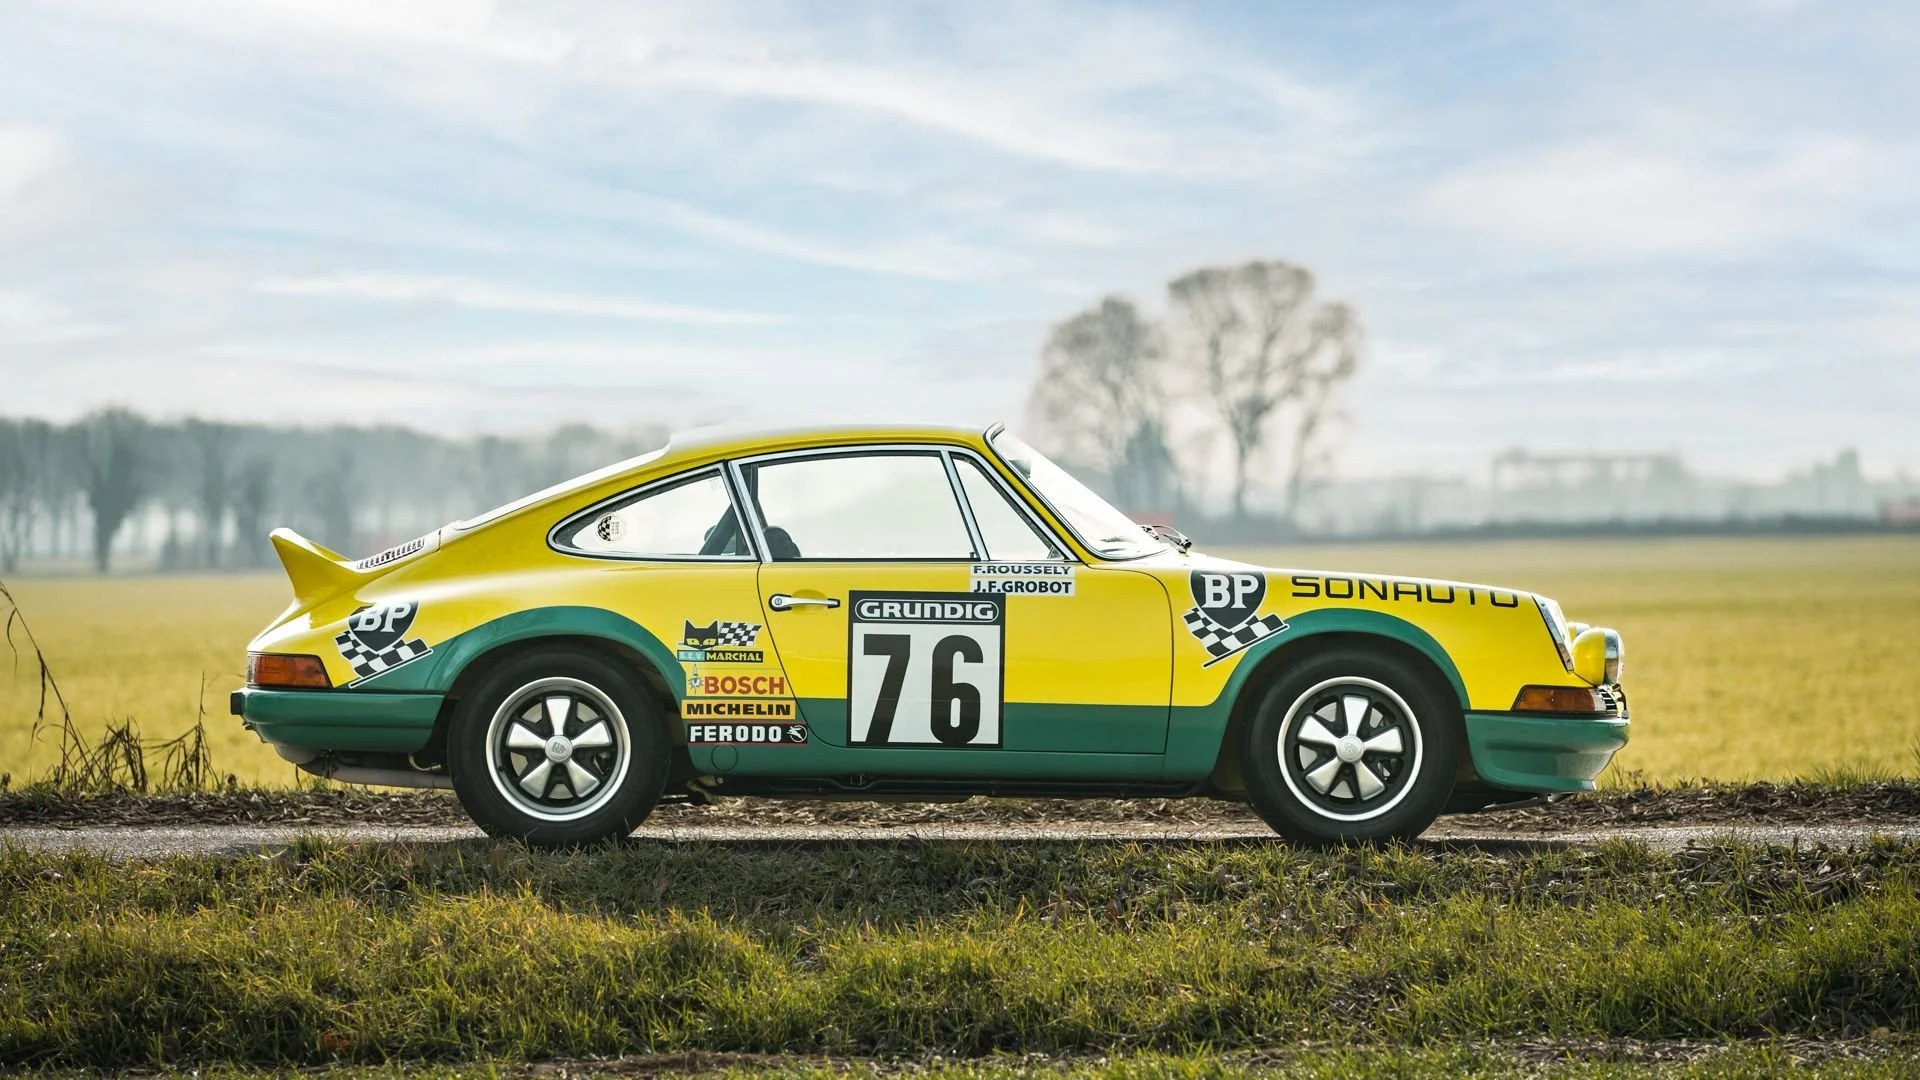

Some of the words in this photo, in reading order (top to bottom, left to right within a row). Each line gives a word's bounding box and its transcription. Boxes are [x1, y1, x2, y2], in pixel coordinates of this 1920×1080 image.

[973, 565, 1071, 575] F.ROUSSELY
[973, 581, 1072, 594] J.F.GROBOT
[1200, 574, 1259, 609] BP
[1291, 575, 1518, 608] SONAUTO
[353, 602, 412, 633] BP
[860, 601, 994, 620] GRUNDIG
[706, 652, 762, 661] MARCHAL
[704, 676, 785, 695] BOSCH
[863, 633, 984, 744] 76
[686, 703, 791, 716] MICHELIN
[690, 725, 782, 742] FERODO
